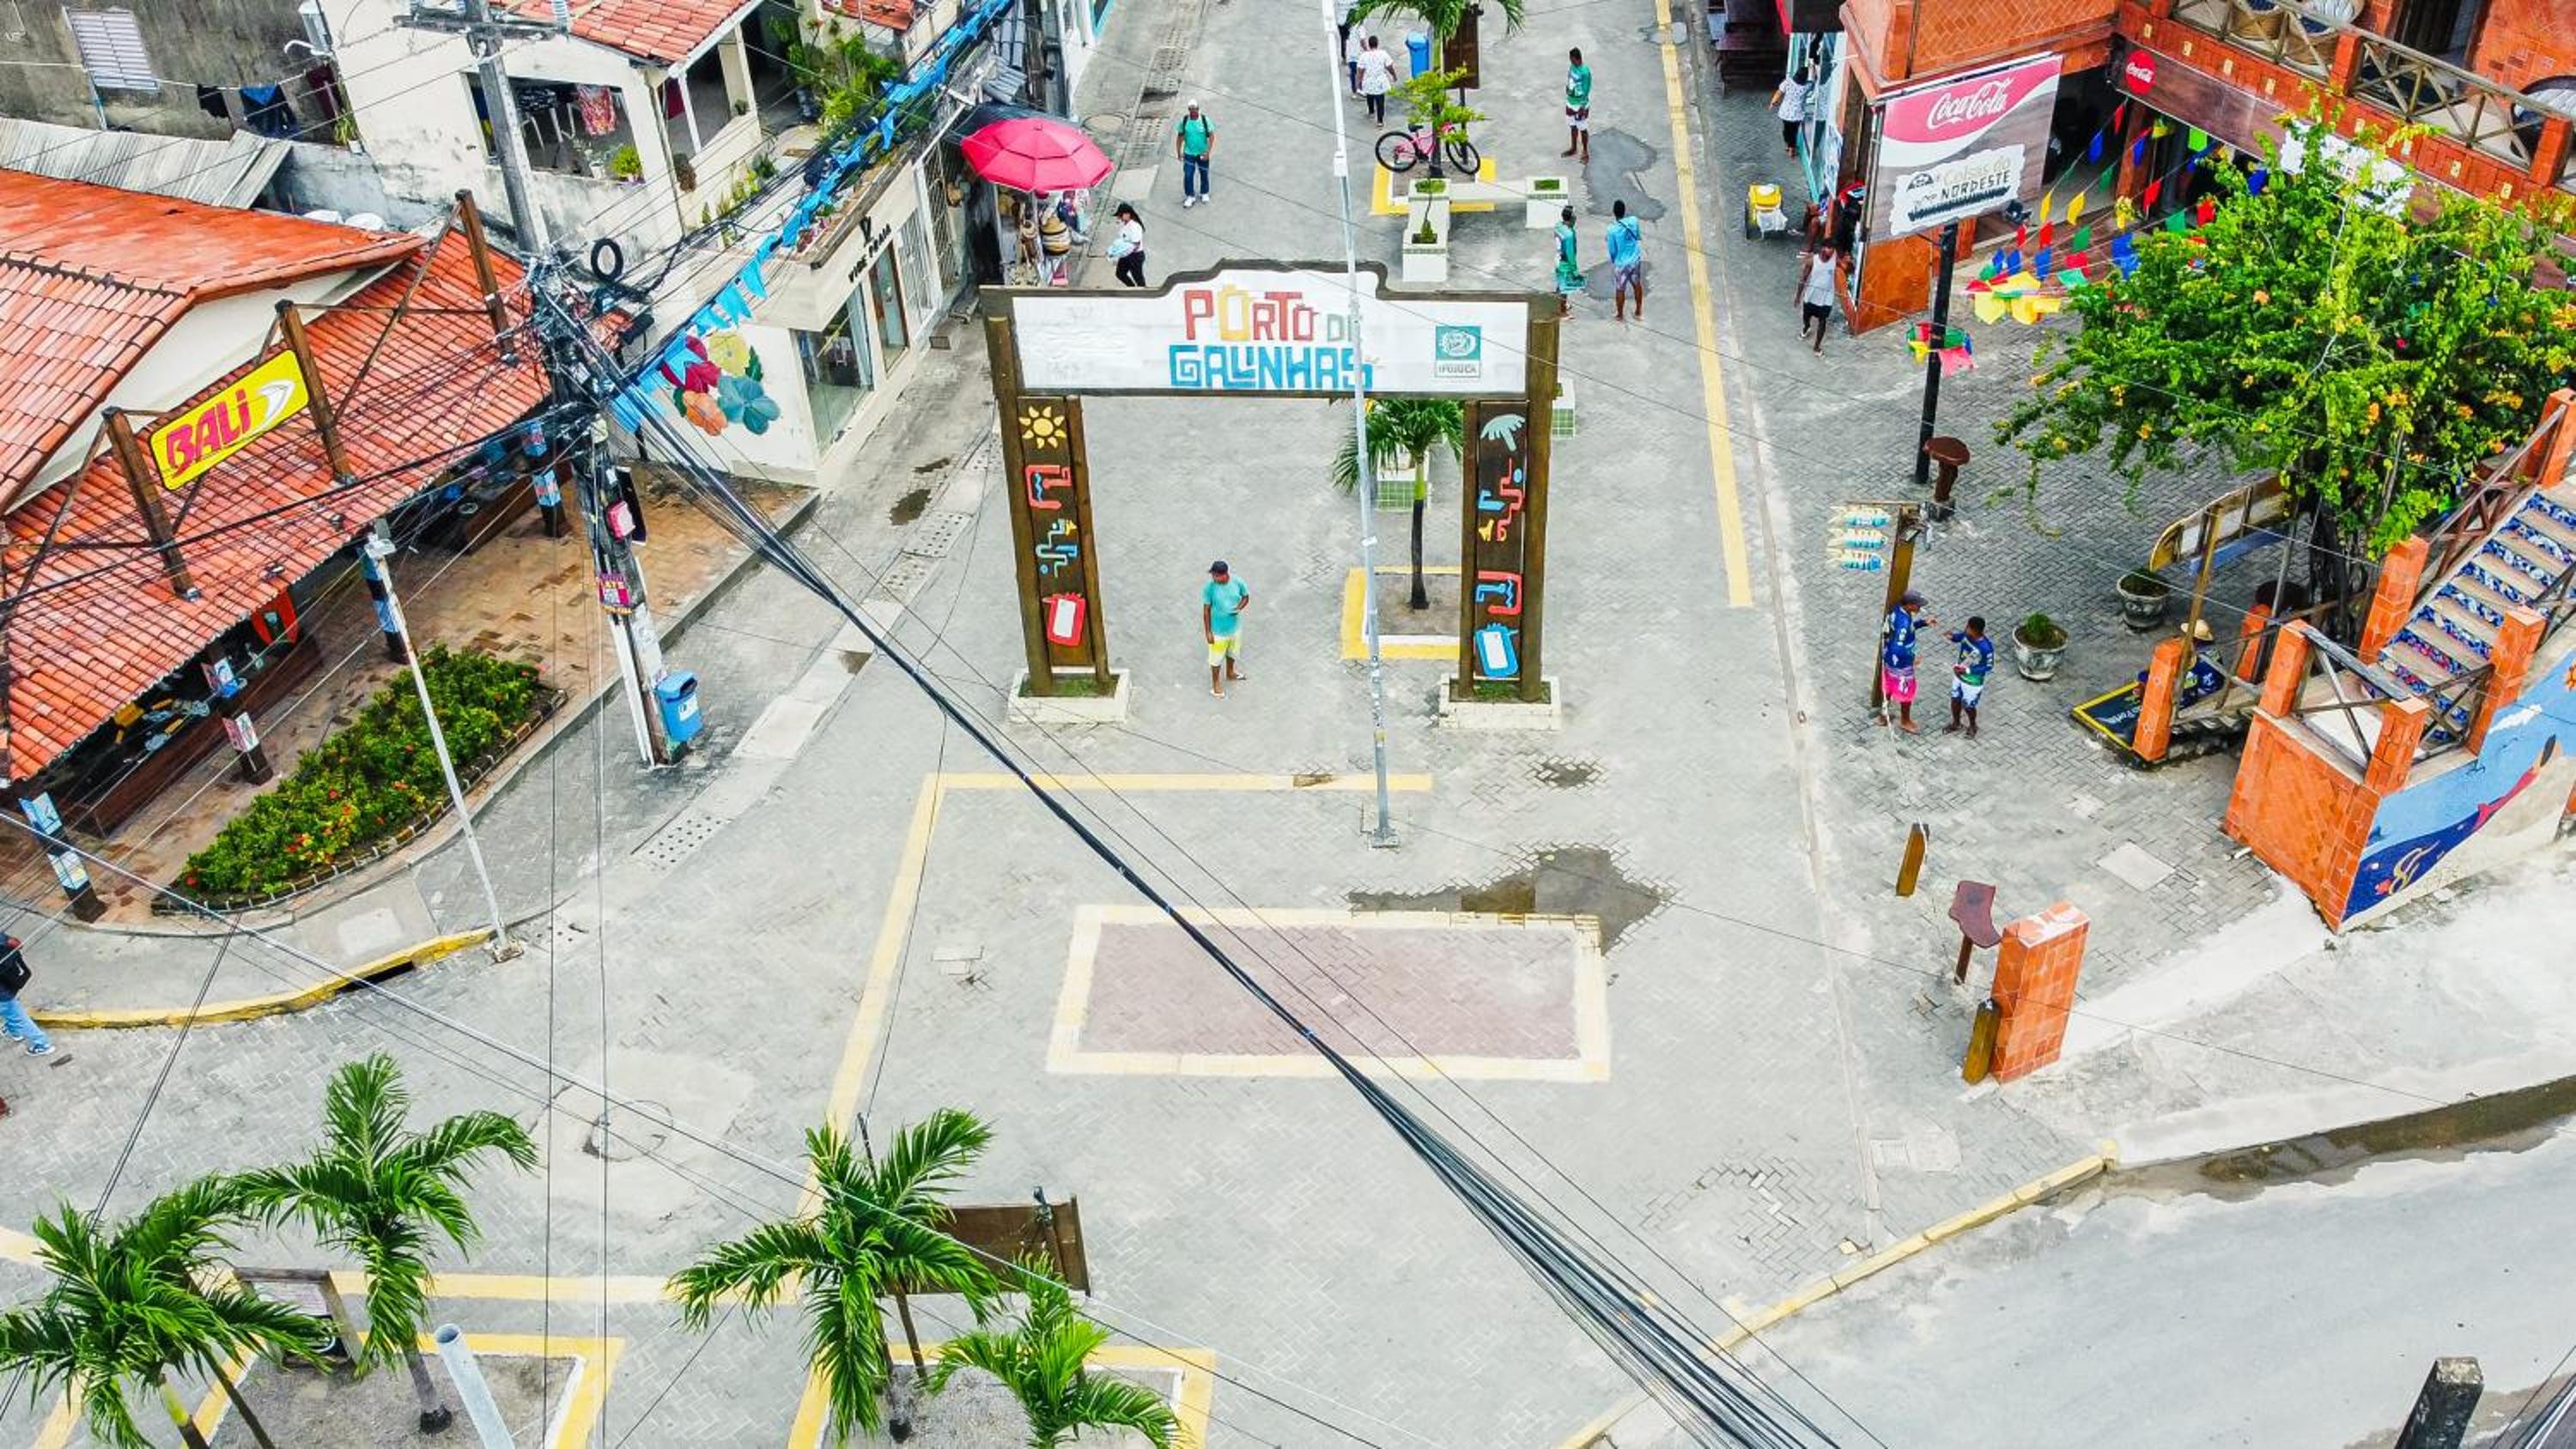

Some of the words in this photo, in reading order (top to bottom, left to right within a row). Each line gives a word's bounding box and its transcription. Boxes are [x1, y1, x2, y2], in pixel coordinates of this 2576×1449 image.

[1927, 77, 2014, 129] Coca-Cola
[1942, 169, 2010, 198] NORDESTE
[1184, 284, 1318, 342] PORTO
[1170, 344, 1372, 389] GALINHAS
